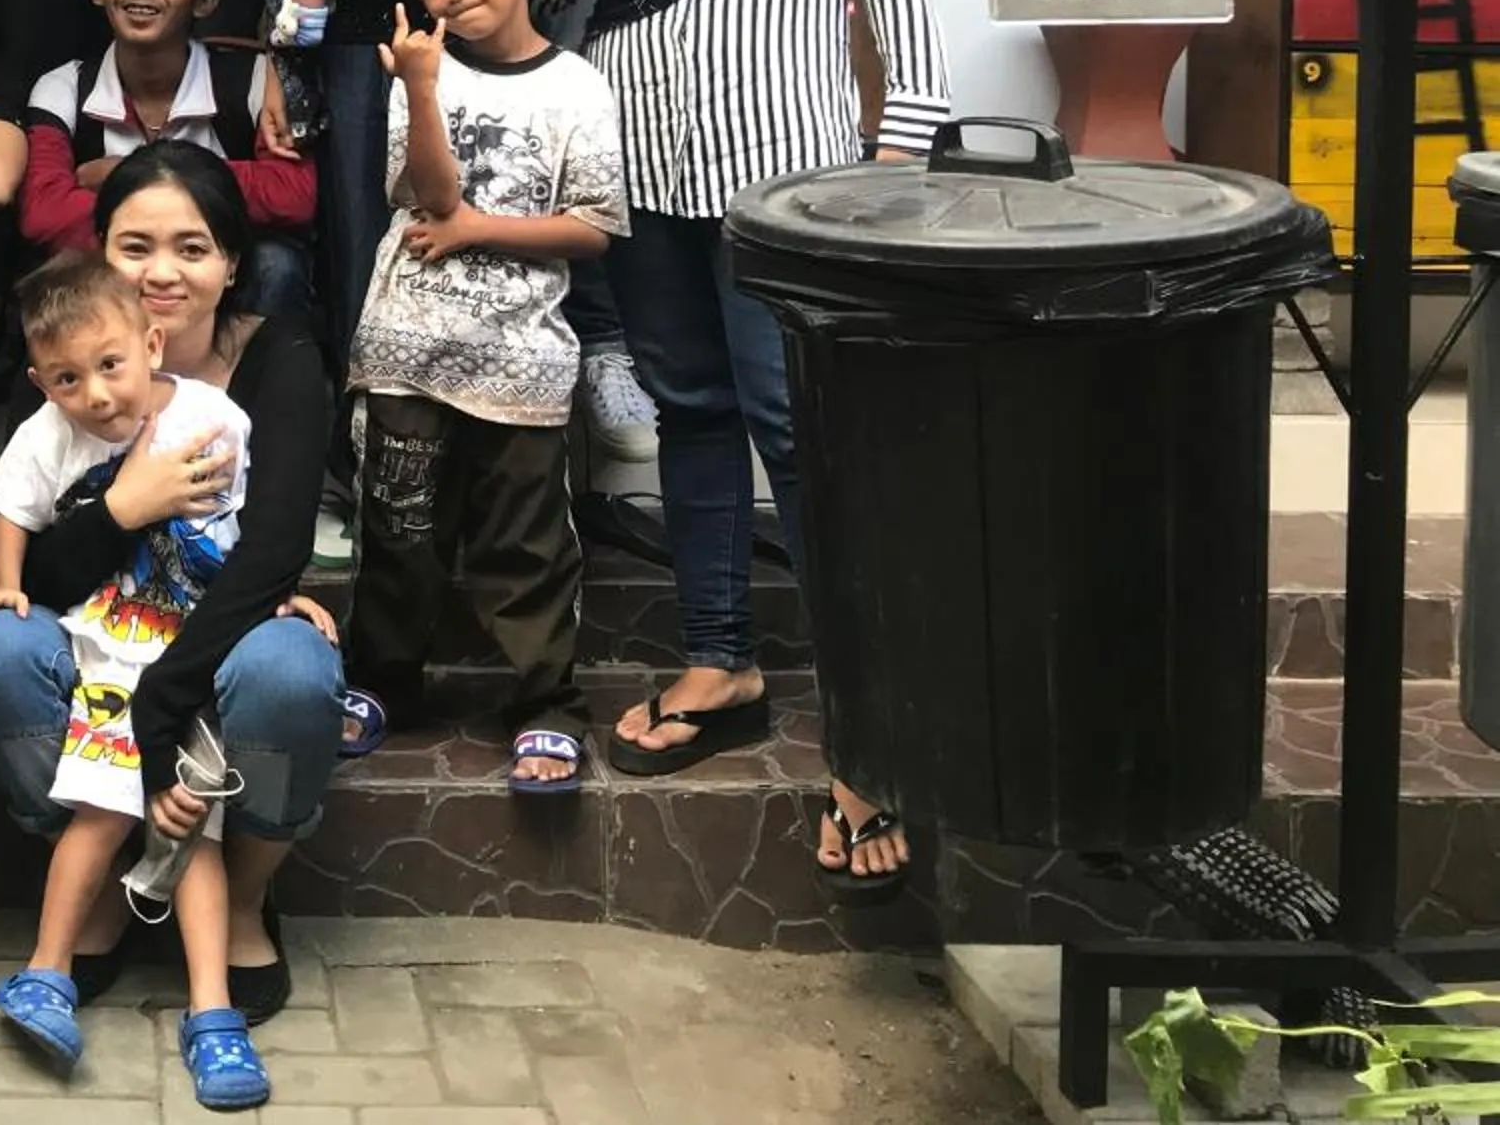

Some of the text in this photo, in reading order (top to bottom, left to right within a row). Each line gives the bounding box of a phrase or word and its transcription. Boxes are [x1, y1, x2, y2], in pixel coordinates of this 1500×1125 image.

[1303, 62, 1321, 82] 9
[344, 696, 369, 718] LA
[517, 735, 577, 758] FILA
